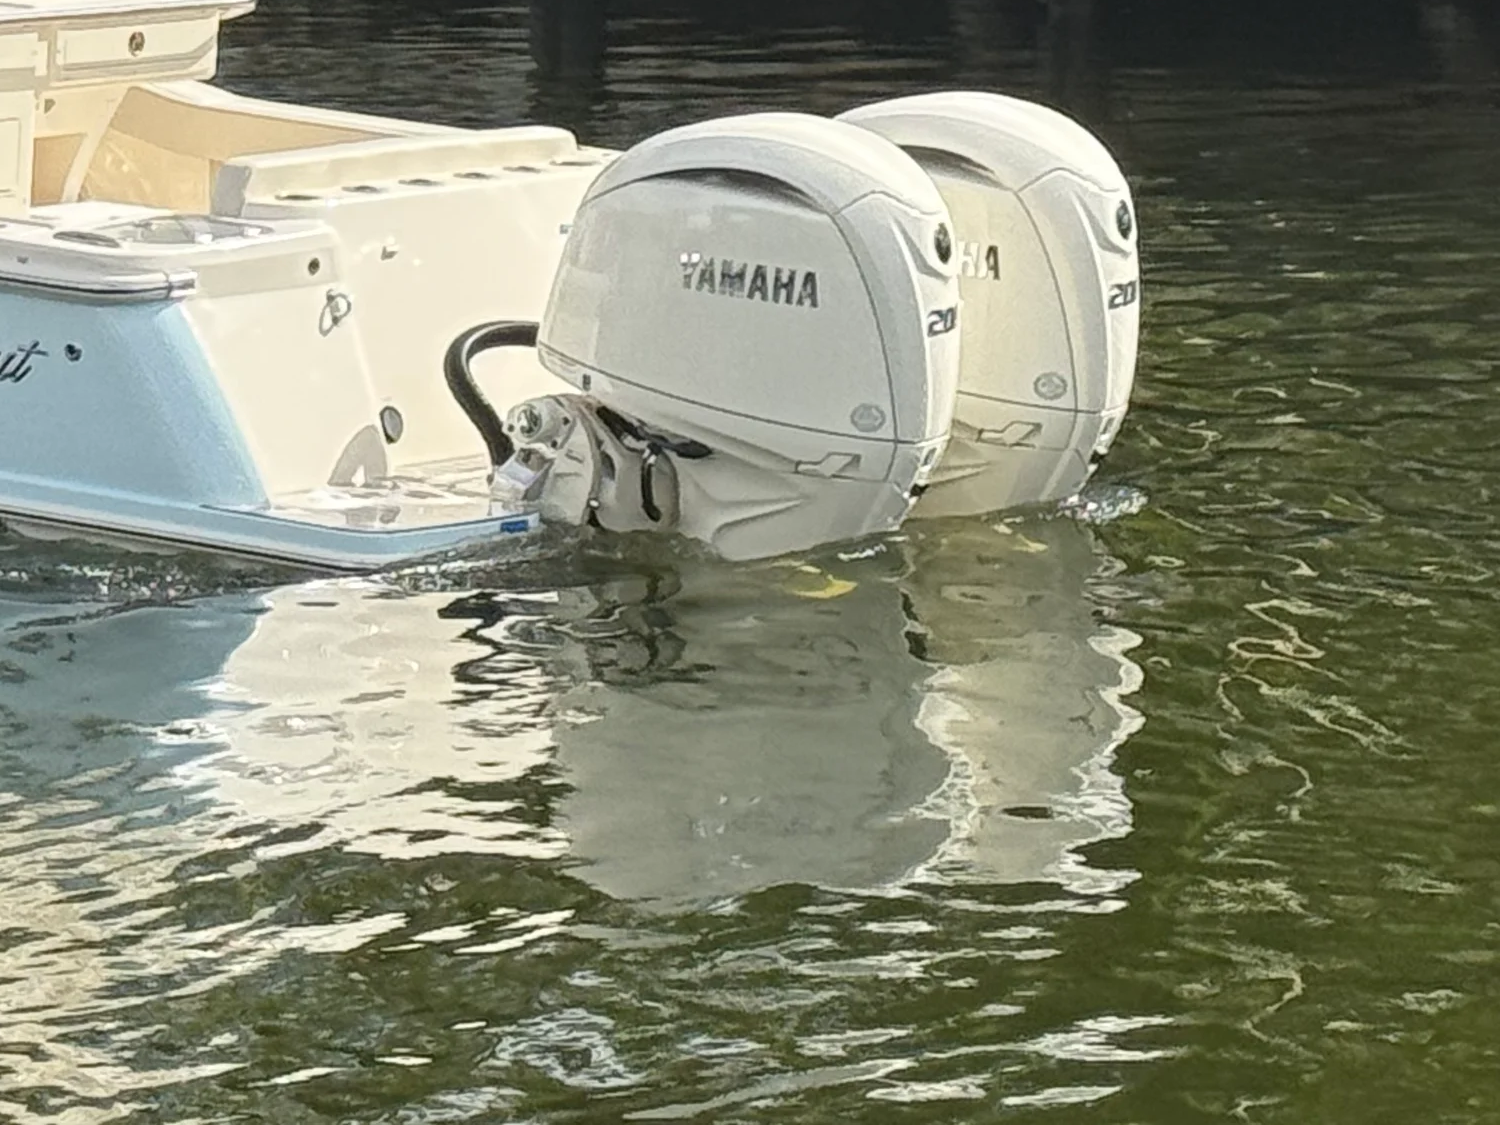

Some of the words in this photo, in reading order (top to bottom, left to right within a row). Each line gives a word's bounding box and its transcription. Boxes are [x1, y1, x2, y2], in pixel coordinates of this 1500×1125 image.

[679, 252, 819, 308] YAMAHA
[1108, 280, 1137, 310] 20
[927, 303, 958, 337] 20
